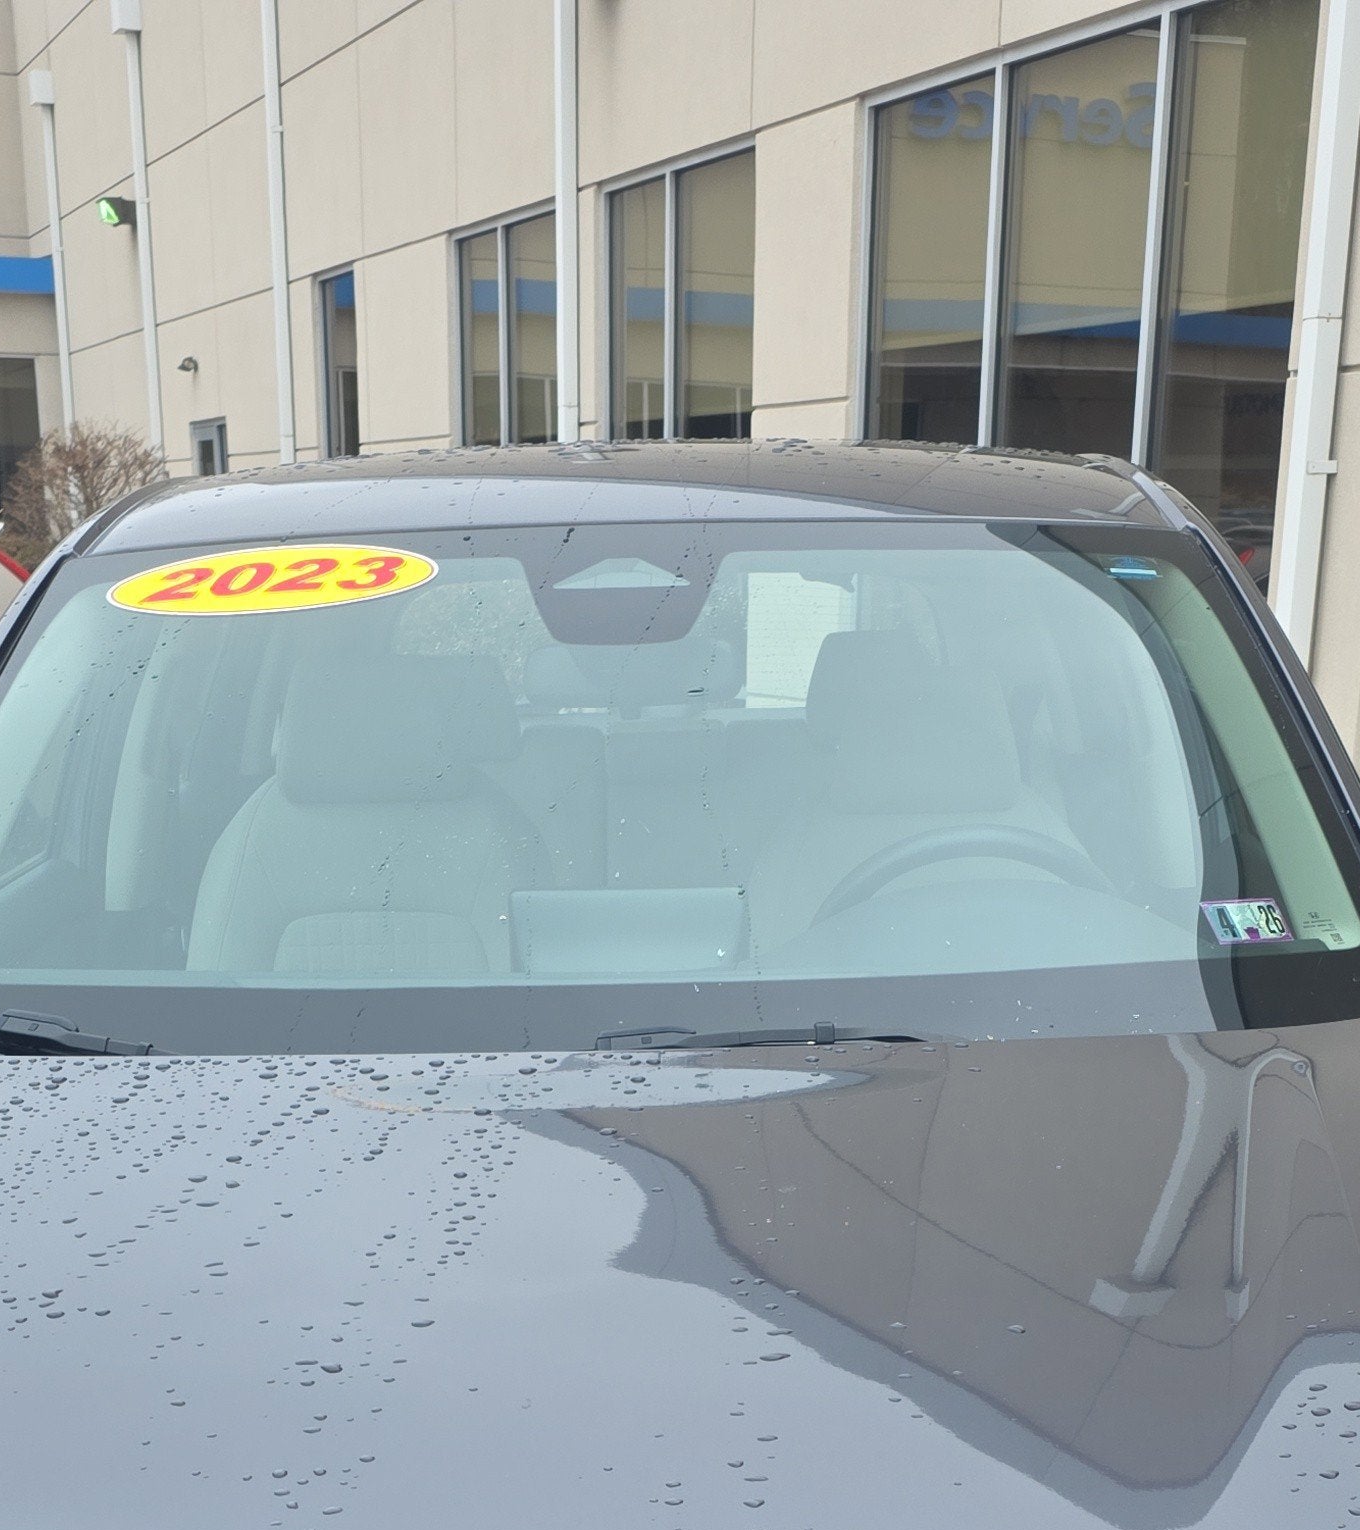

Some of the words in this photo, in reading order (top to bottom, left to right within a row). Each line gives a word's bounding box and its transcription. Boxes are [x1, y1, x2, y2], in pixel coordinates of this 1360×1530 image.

[139, 556, 407, 605] 2023
[1216, 906, 1239, 938] 4
[1257, 904, 1286, 934] 26
